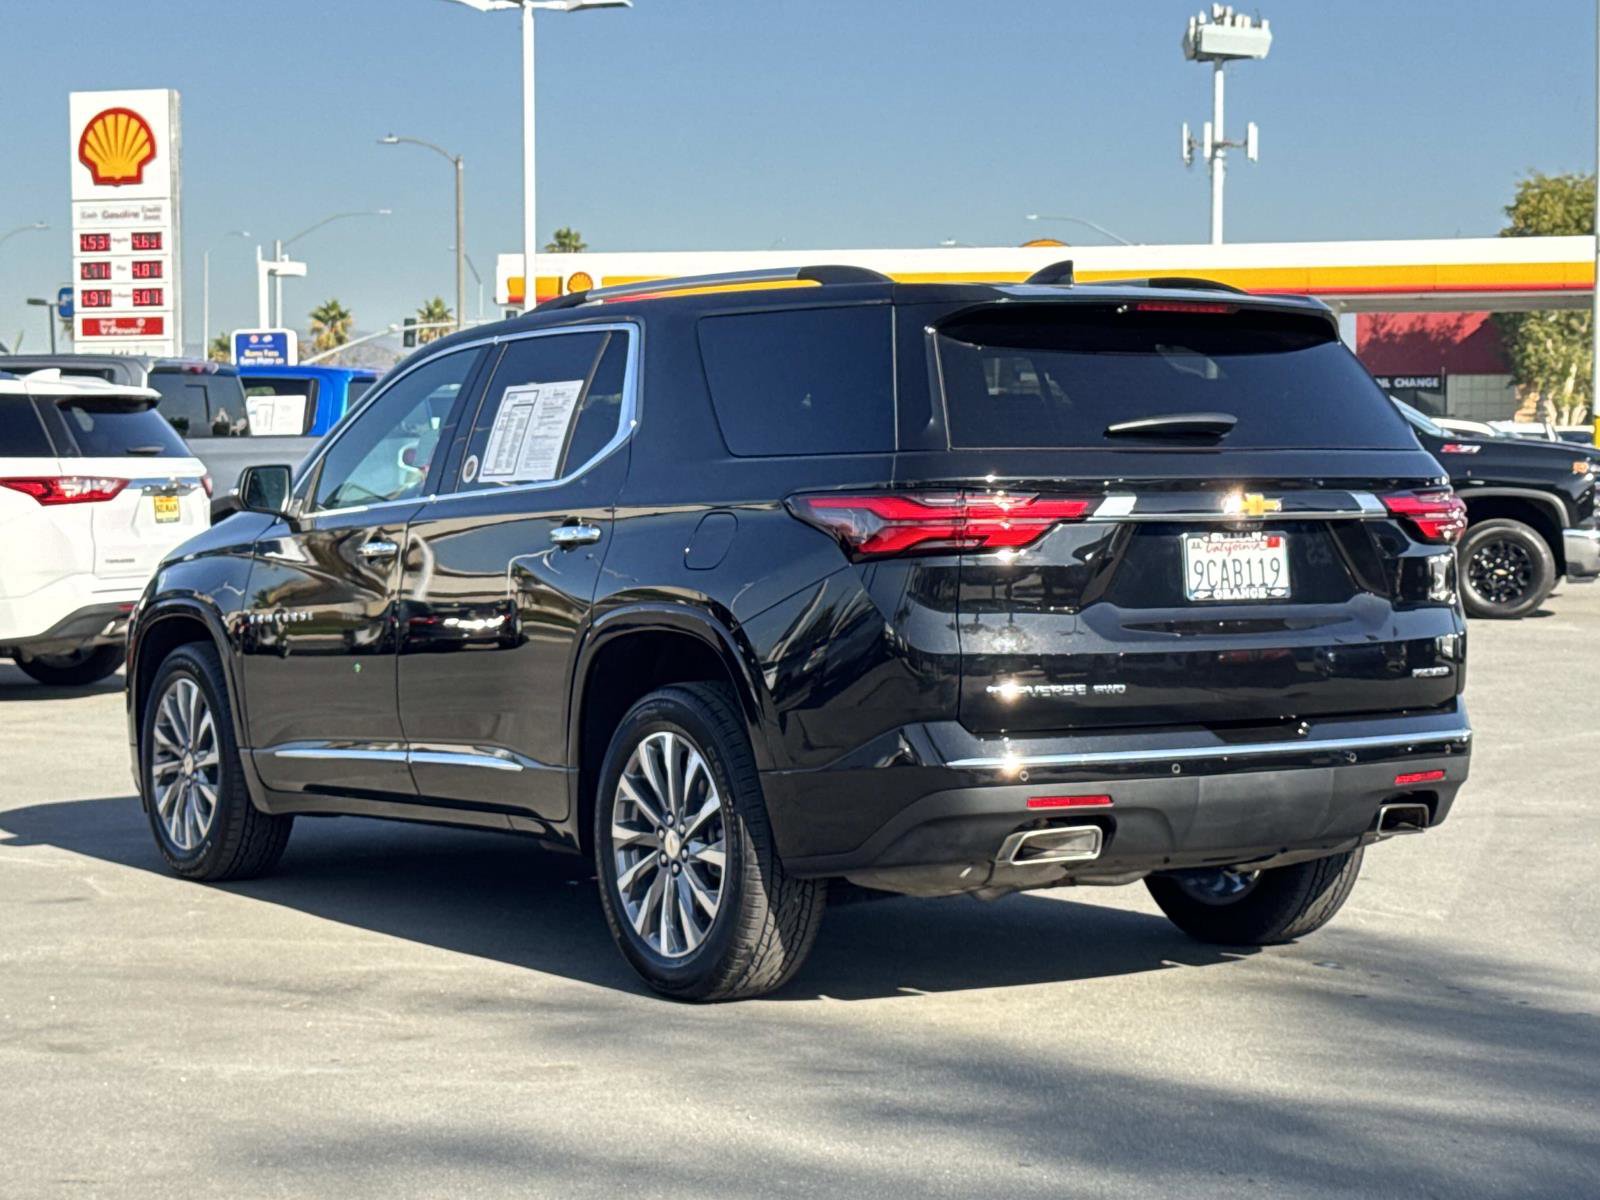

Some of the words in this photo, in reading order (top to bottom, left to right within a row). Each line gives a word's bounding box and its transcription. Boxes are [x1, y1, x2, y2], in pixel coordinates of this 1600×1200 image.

[1394, 377, 1439, 388] CHANGE
[1193, 557, 1280, 590] 9CAB119
[986, 683, 1086, 697] VERSE
